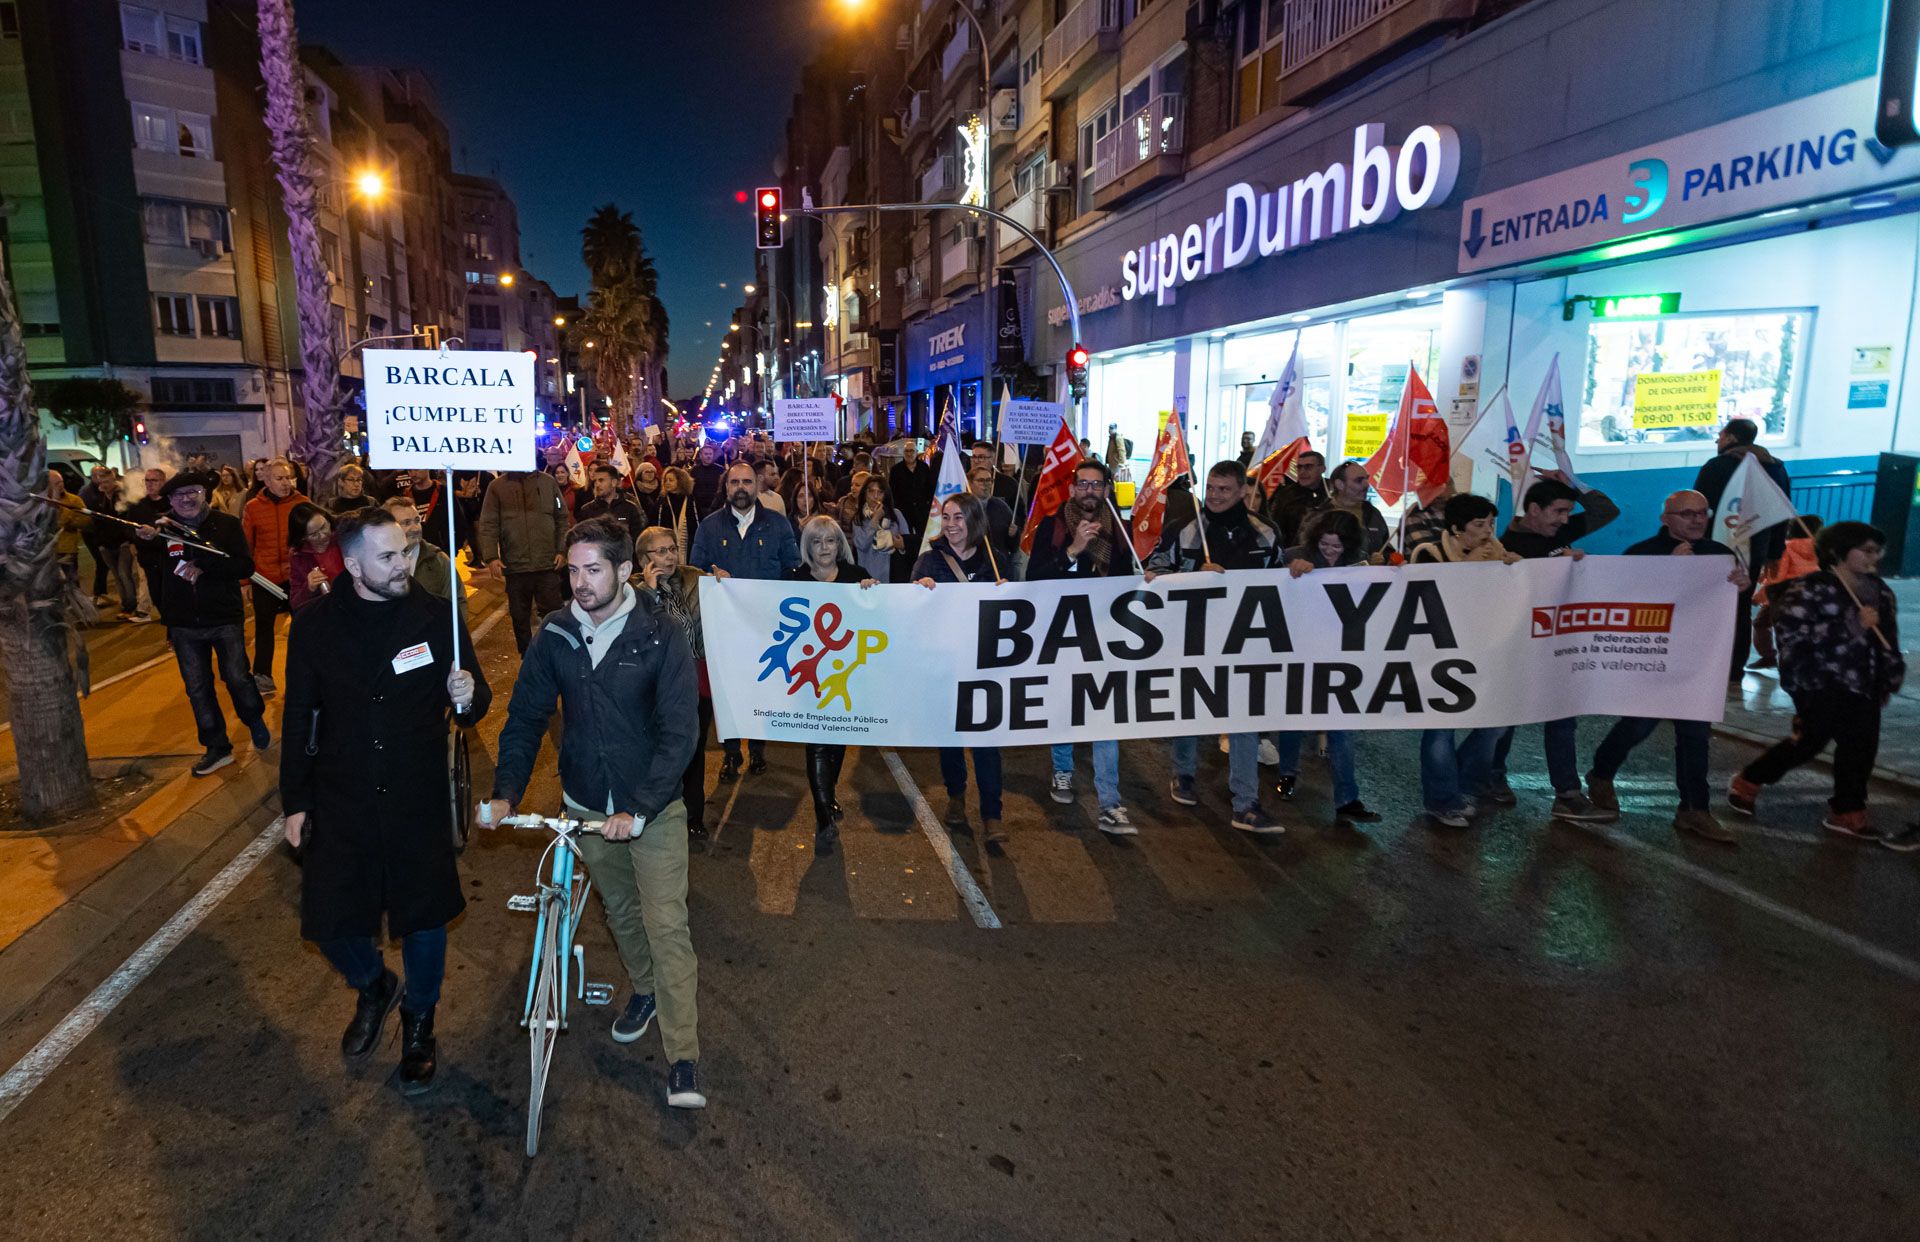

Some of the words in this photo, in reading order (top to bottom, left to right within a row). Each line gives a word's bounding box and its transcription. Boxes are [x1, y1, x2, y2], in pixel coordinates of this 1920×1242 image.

[1491, 194, 1609, 247] ENTRADA
[1683, 128, 1858, 202] PARKING
[1122, 124, 1447, 306] superDumbo
[928, 323, 966, 357] TREK
[385, 366, 515, 387] BARCALA
[1637, 375, 1686, 385] DOMINGOS
[1648, 388, 1659, 396] DE
[1661, 386, 1707, 395] DICIEMBRE
[385, 405, 488, 425] ¡CUMPLE
[494, 404, 524, 424] TÚ
[1635, 404, 1672, 413] HORARIO
[1674, 403, 1717, 412] APERTURA
[1642, 414, 1674, 424] 09:00
[1682, 412, 1712, 422] 15:00
[391, 435, 513, 455] PALABRA!
[976, 586, 1294, 670] BASTA
[1322, 580, 1458, 652] YA
[1559, 608, 1630, 627] CCOO
[1593, 633, 1651, 644] federació
[1654, 634, 1670, 644] de
[1590, 643, 1601, 653] la
[1601, 659, 1667, 673] valencià
[955, 675, 1049, 732] DE
[1071, 659, 1477, 726] MENTIRAS
[753, 709, 791, 720] Sindicato
[793, 711, 805, 720] de
[806, 711, 852, 724] Empleados
[854, 714, 889, 725] Públicos
[771, 720, 820, 731] Comunidad
[821, 722, 870, 733] Valenciana
